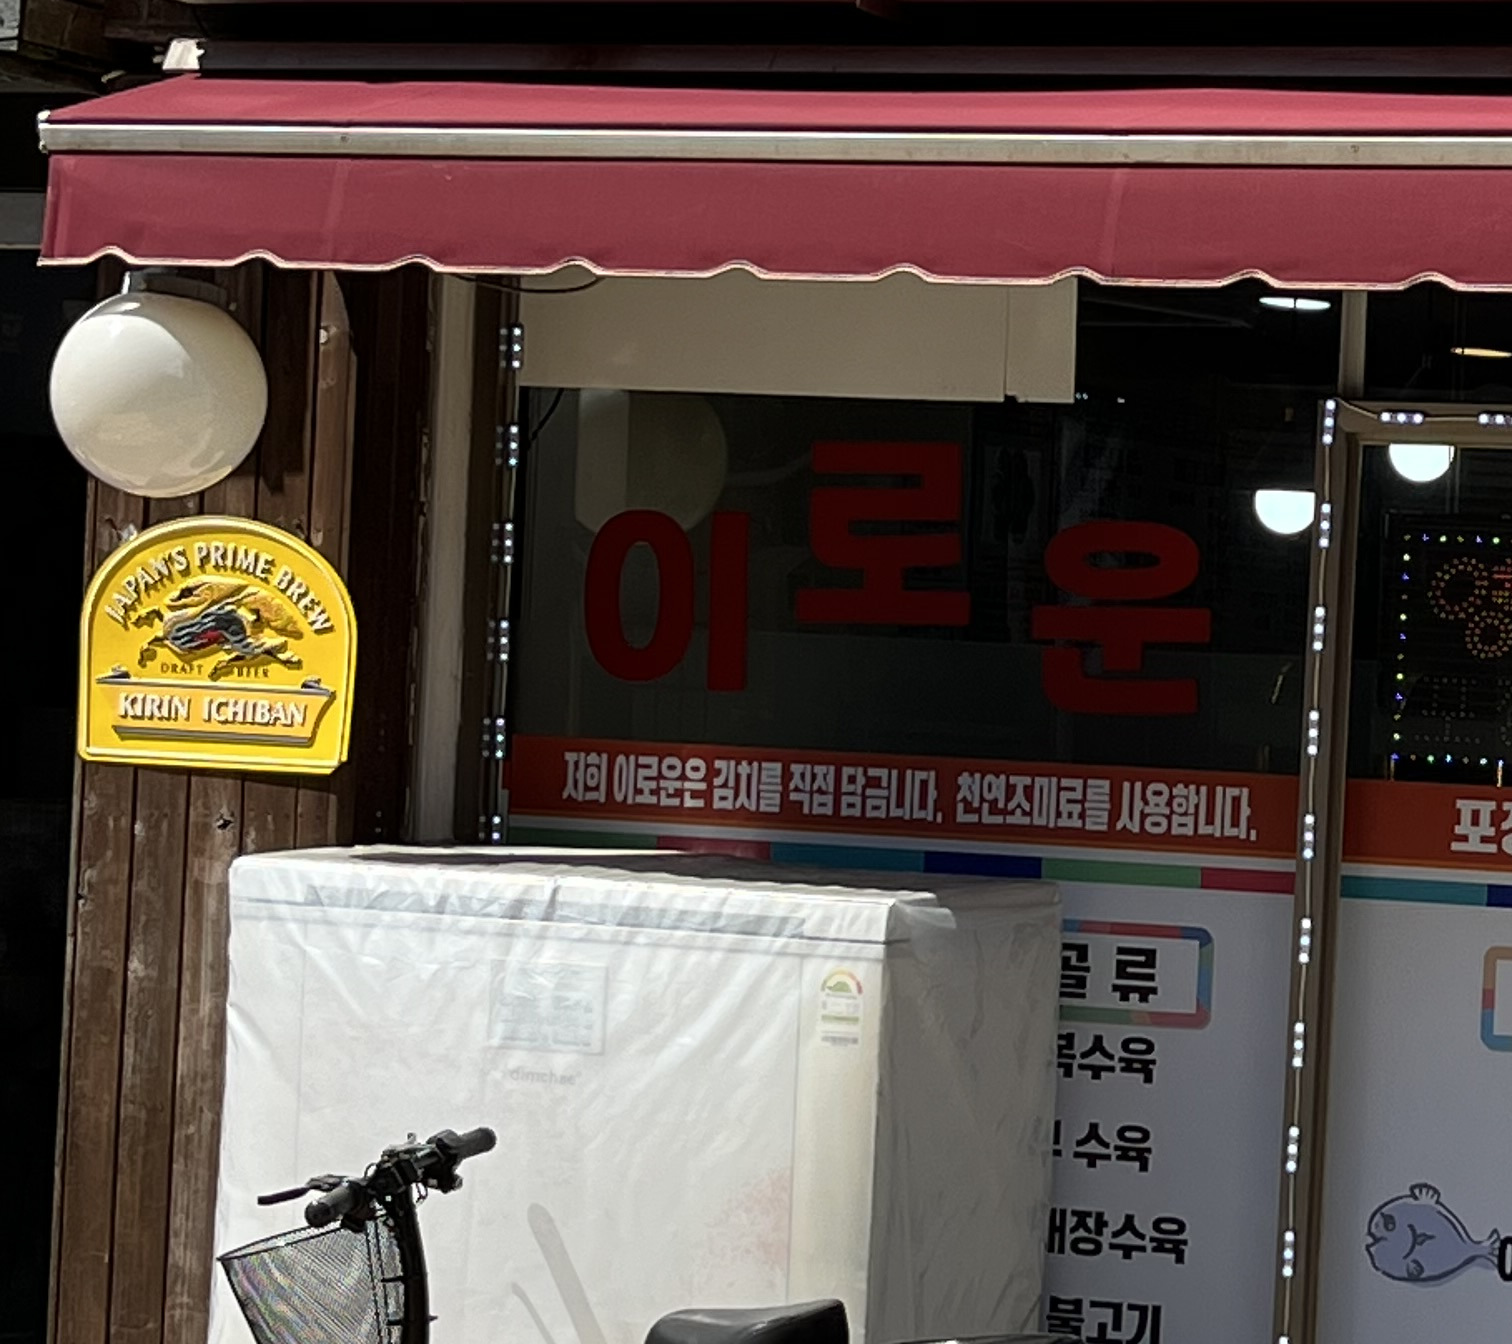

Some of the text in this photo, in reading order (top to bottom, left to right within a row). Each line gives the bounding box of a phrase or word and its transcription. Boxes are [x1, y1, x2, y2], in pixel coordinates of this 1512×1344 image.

[105, 542, 335, 634] JAPAN'S PRIME BREW
[584, 439, 1212, 715] 이로운
[119, 691, 307, 727] KIRIN ICHIBAN
[562, 751, 608, 804] 저희
[612, 753, 707, 808] 이로운은
[712, 759, 782, 814] 김치를
[789, 763, 835, 817] 직접
[956, 771, 1111, 833] 천연조미료를
[1115, 780, 1257, 842] 사용합니다.
